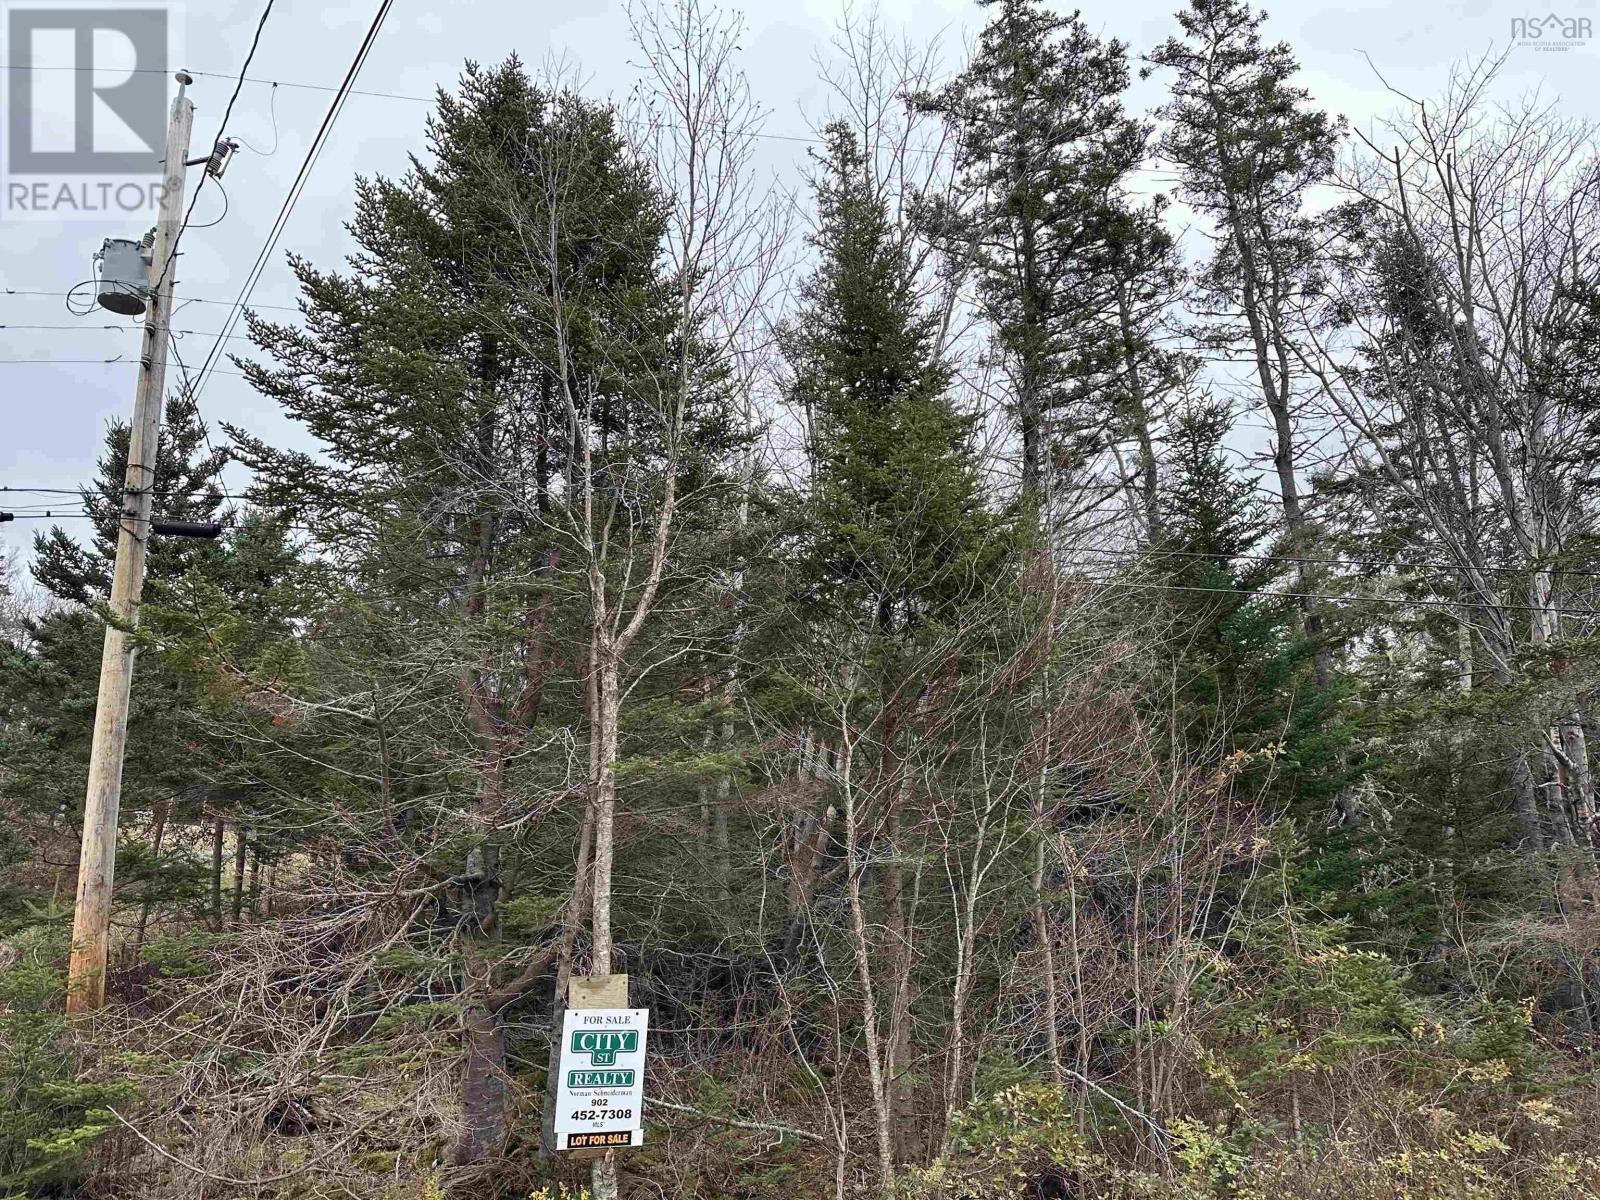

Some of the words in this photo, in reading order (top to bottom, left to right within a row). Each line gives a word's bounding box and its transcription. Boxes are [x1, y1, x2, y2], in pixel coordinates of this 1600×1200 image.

[583, 1016, 603, 1025] FOR
[605, 1015, 631, 1024] SALE
[580, 1033, 630, 1050] CITY
[596, 1053, 610, 1063] ST
[574, 1072, 629, 1086] REALTY
[593, 1089, 633, 1097] Schneiderman
[591, 1098, 608, 1106] 902
[571, 1109, 632, 1120] 452-7308
[570, 1134, 587, 1146] LOT
[588, 1134, 606, 1145] FOR
[607, 1133, 629, 1143] SALE
